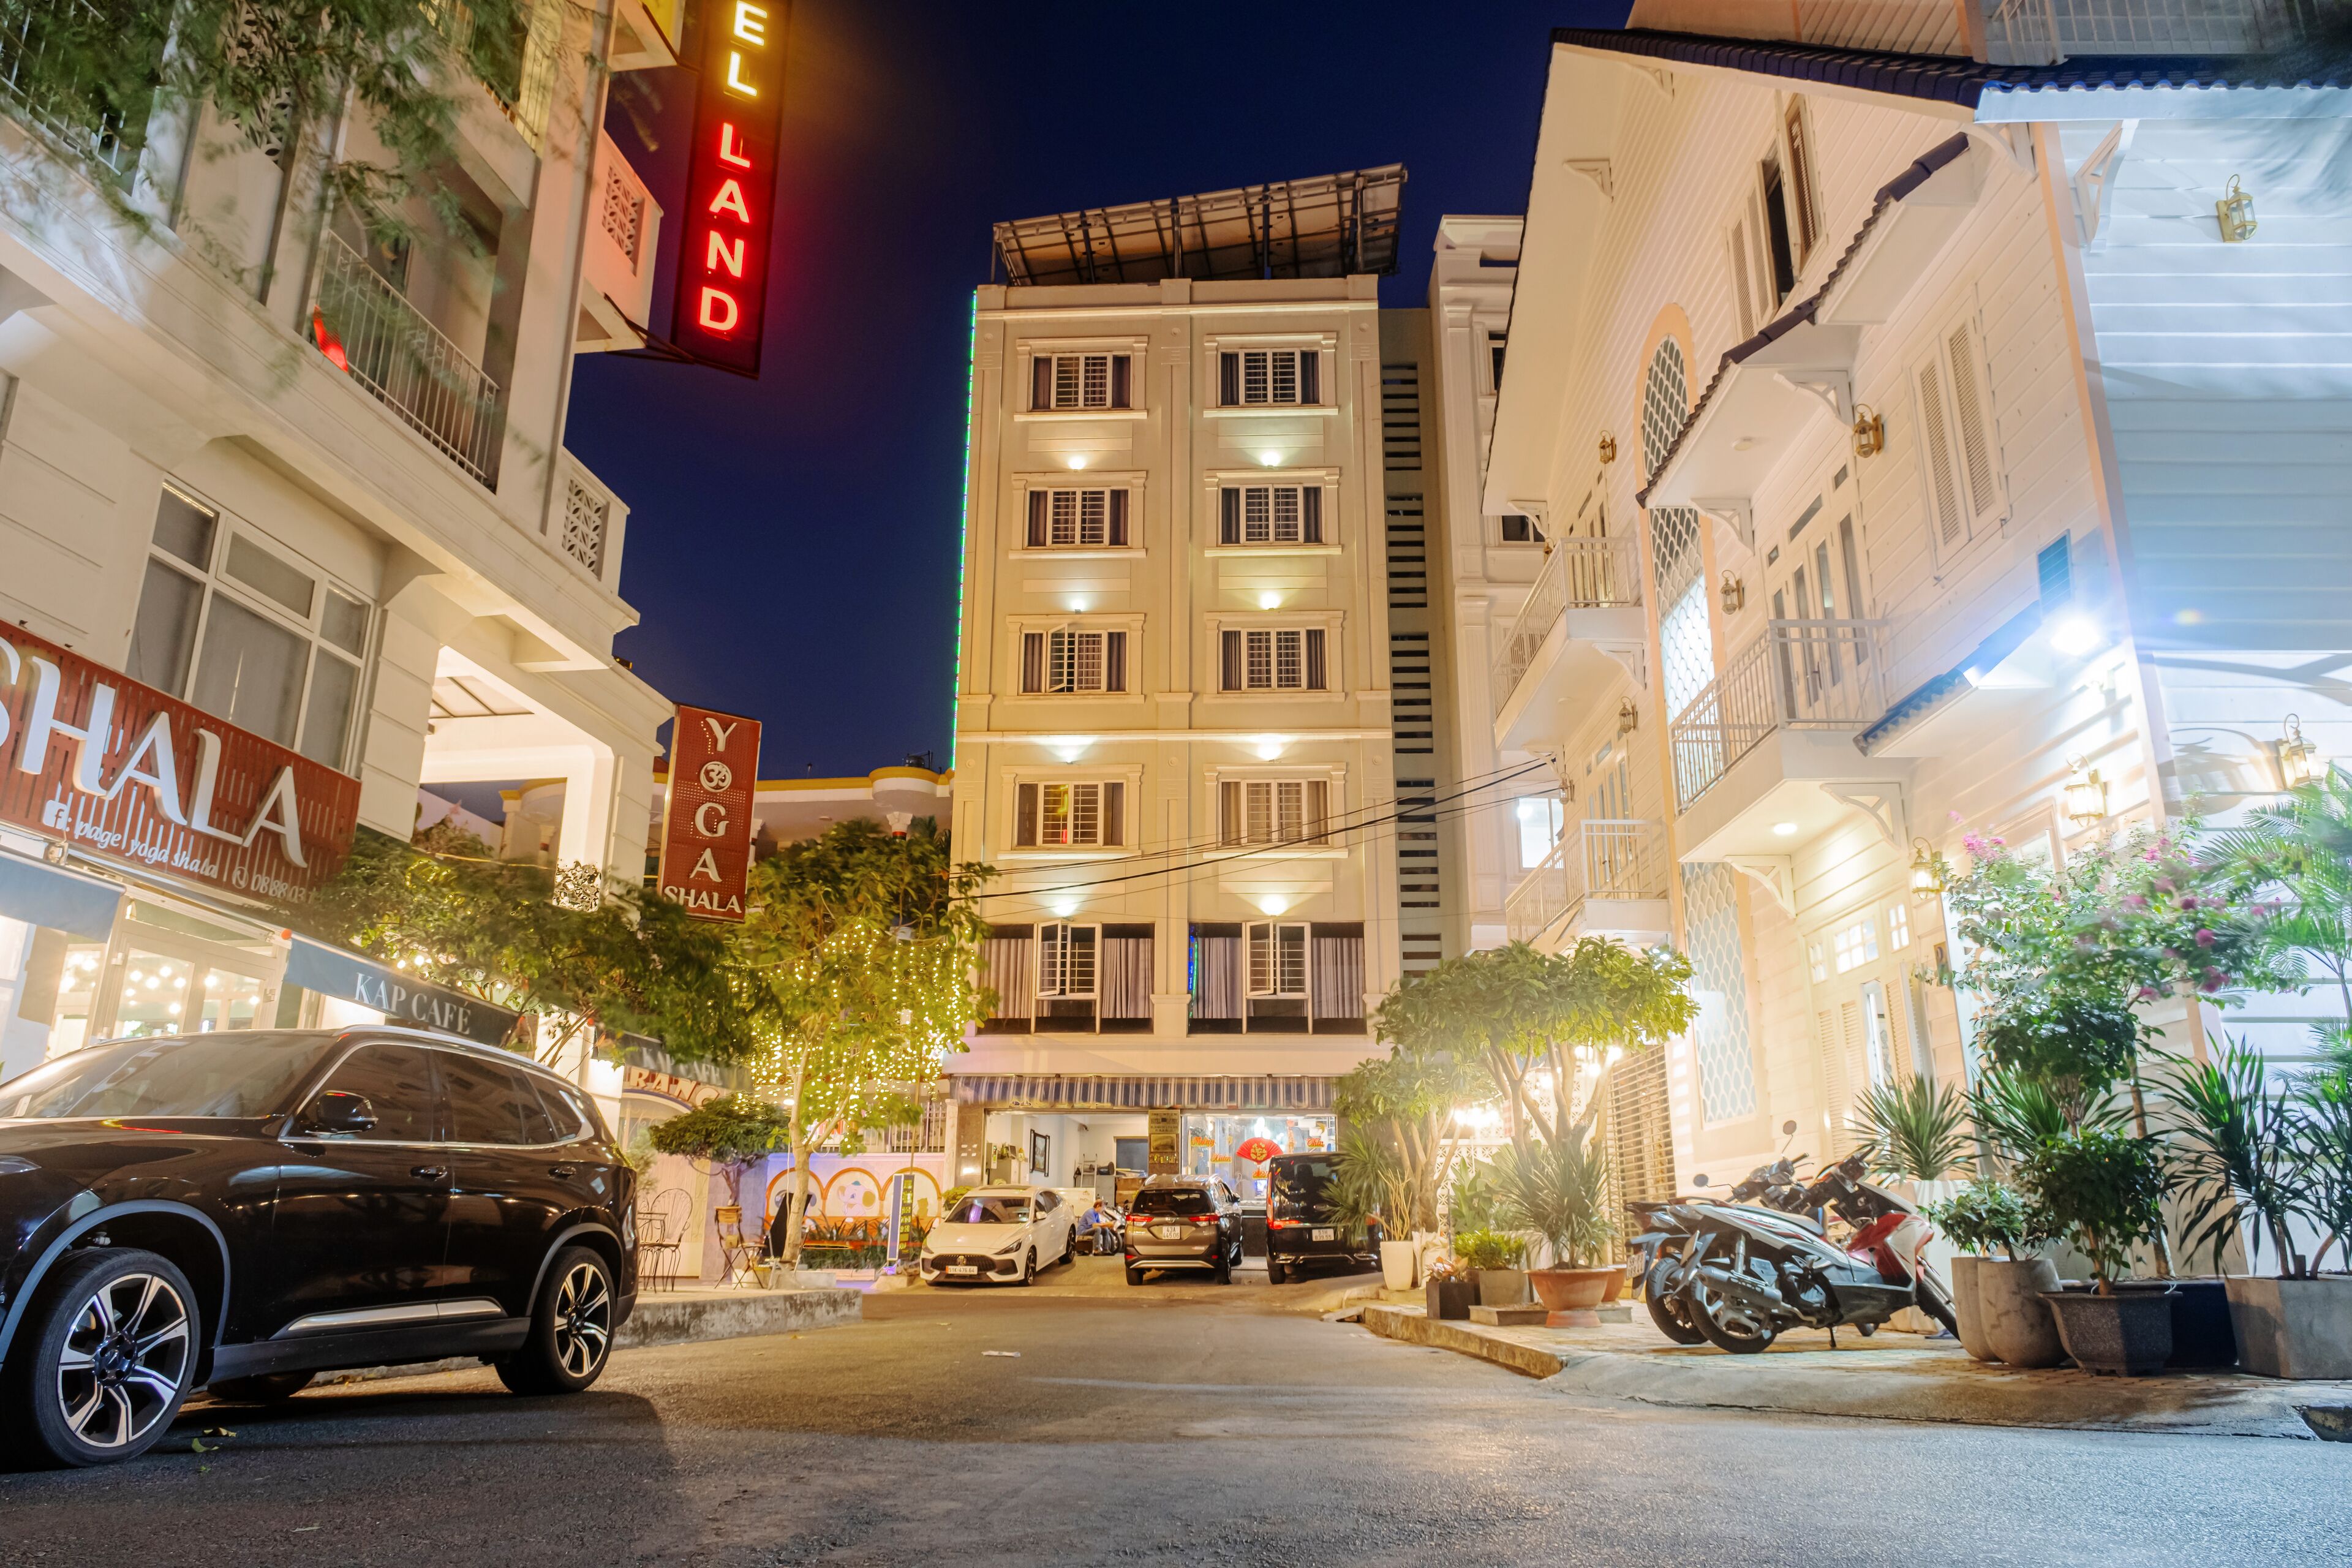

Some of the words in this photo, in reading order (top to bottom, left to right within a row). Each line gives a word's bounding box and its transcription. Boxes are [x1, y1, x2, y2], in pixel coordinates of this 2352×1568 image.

[699, 123, 751, 331] LAND
[75, 821, 122, 849] page
[126, 839, 169, 864] yoga
[171, 851, 217, 879] shala
[664, 886, 742, 913] SHALA
[355, 972, 407, 1012] KAP
[412, 993, 471, 1035] CAFÉ
